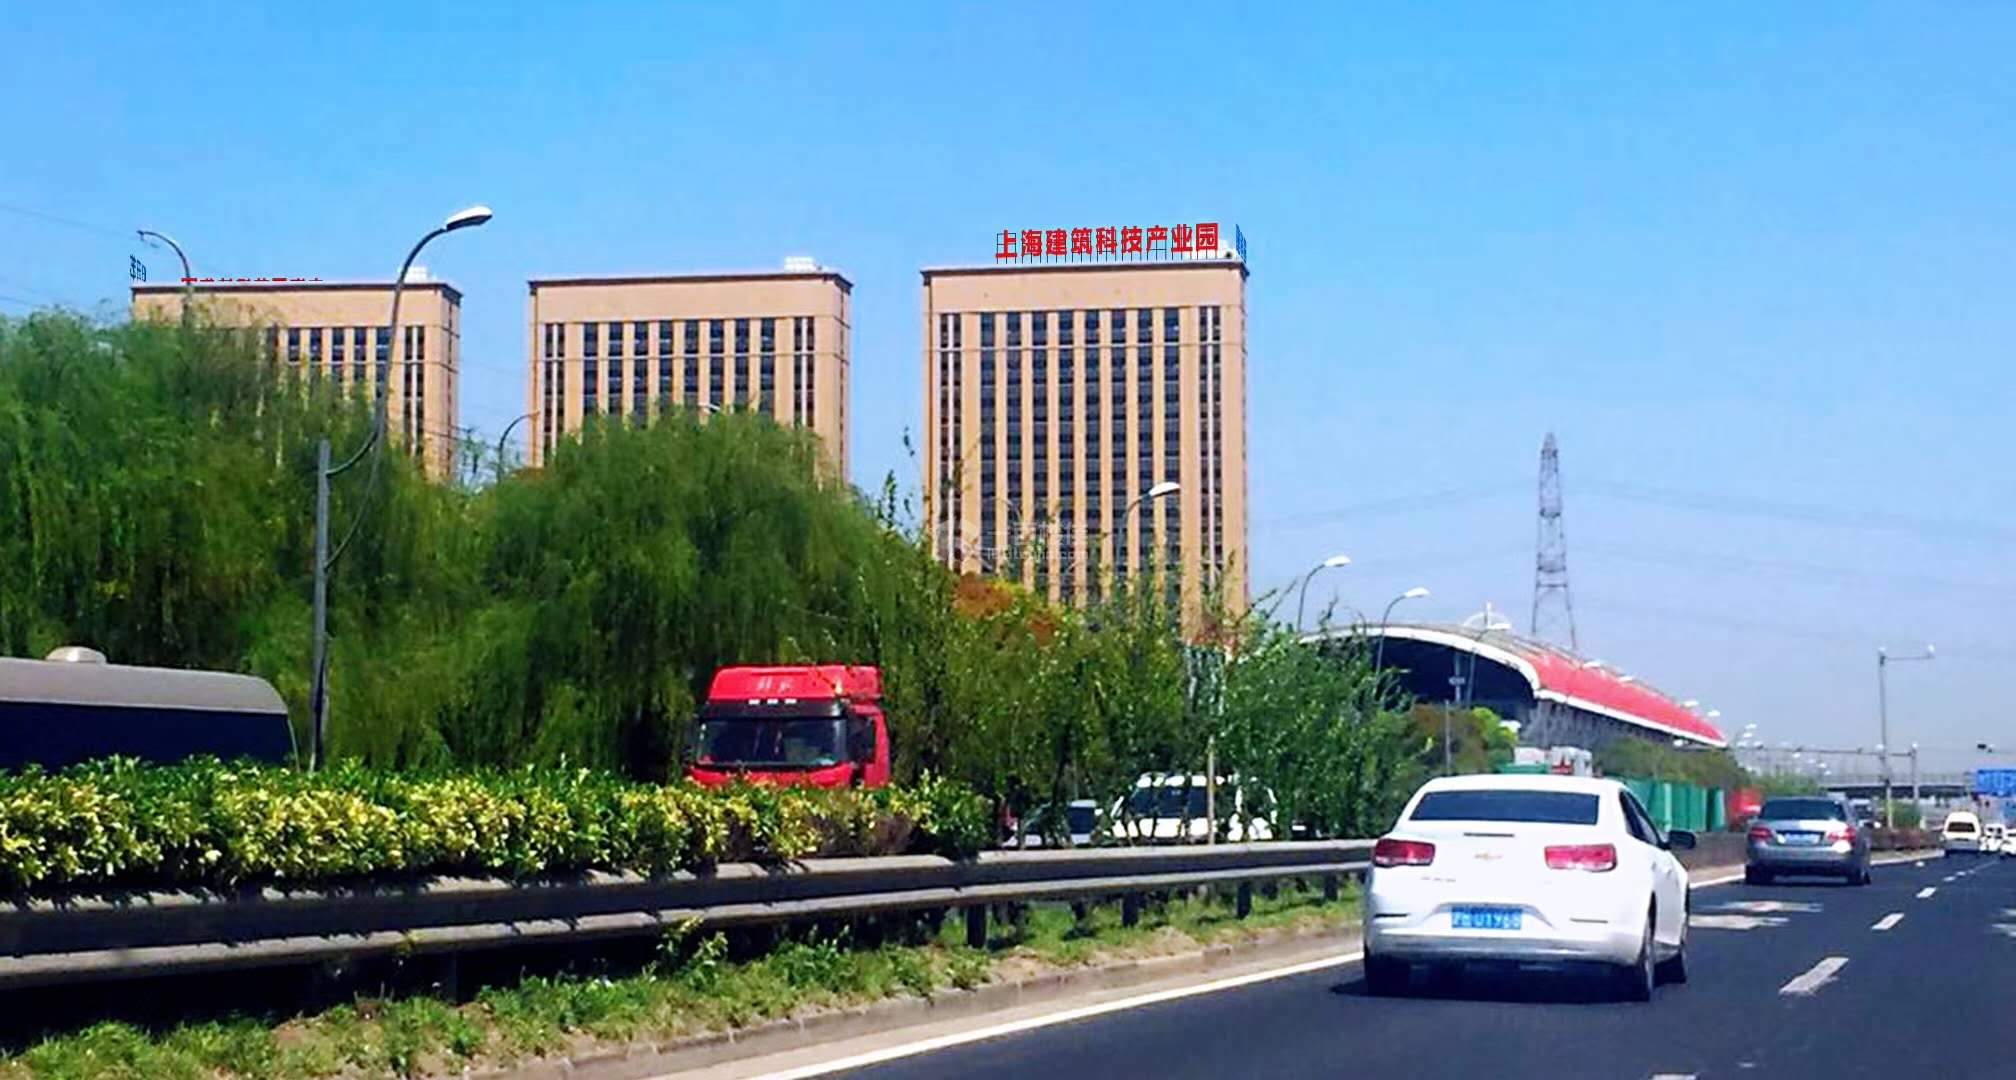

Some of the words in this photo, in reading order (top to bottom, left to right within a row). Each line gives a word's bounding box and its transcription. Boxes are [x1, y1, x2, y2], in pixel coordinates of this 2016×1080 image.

[995, 222, 1218, 259] 上海建筑科技产业园
